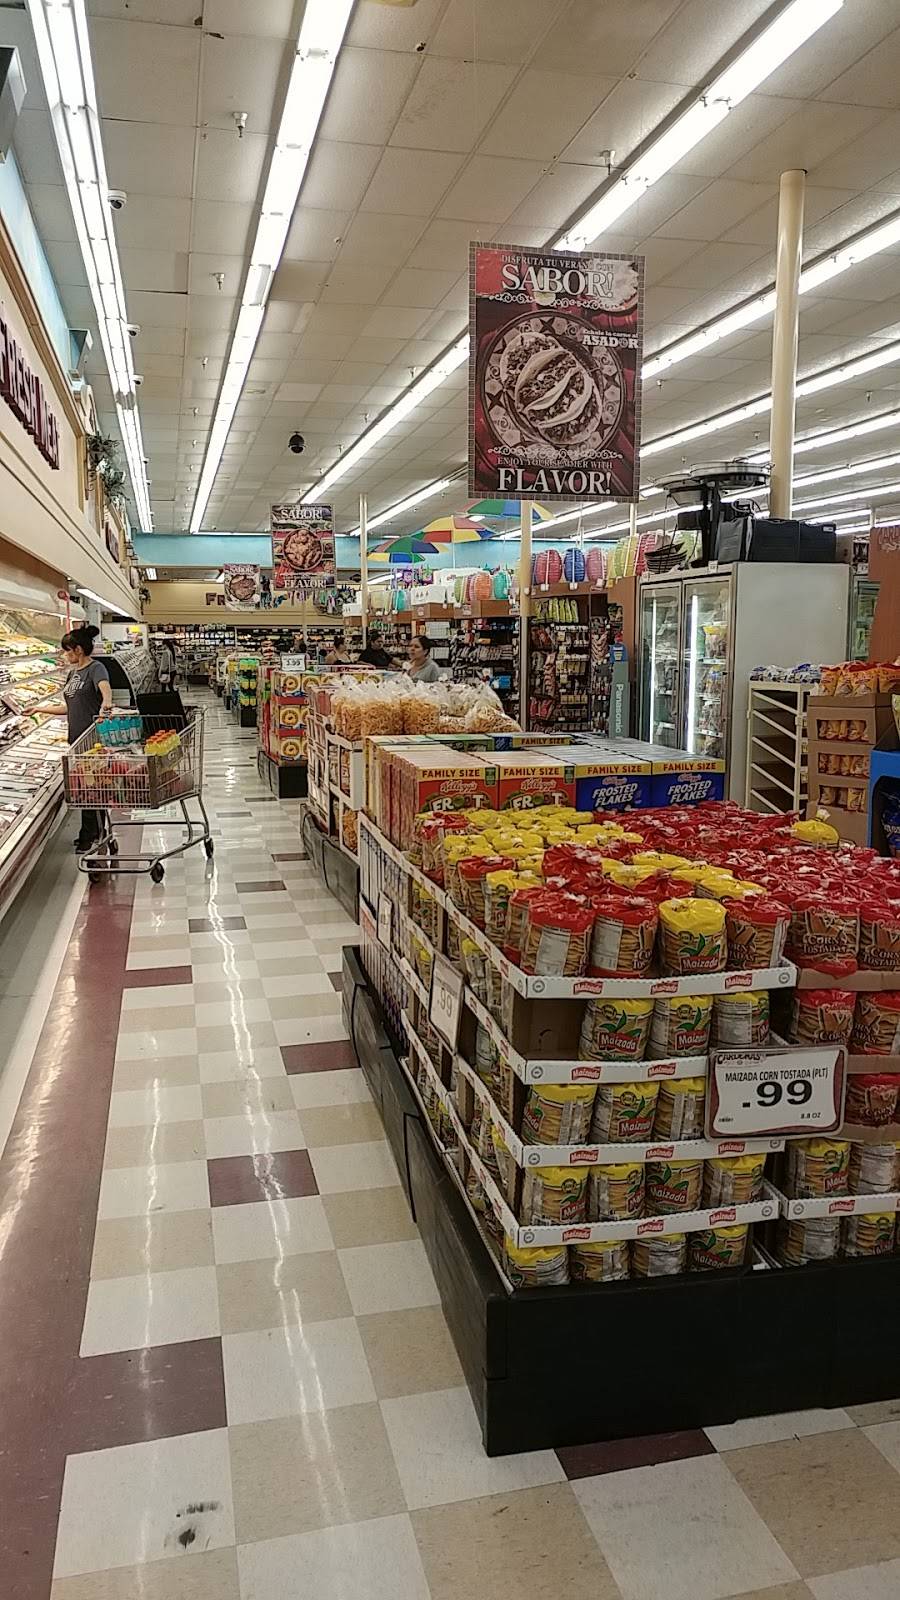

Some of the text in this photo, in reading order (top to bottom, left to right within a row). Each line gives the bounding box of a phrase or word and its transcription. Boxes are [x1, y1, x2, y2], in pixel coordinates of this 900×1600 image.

[501, 254, 545, 266] DISFRUTA
[546, 258, 558, 267] TU
[502, 264, 613, 299] SABOR!
[582, 335, 639, 349] ASADOR
[497, 457, 524, 466] ENJOY
[590, 461, 613, 469] WITH
[497, 467, 612, 494] FLAVOR!
[281, 509, 323, 519] SABOR!
[284, 579, 327, 589] FLAVOR!
[615, 683, 624, 734] Panasonic
[422, 769, 456, 778] FAMILY
[459, 769, 480, 777] SIZE
[504, 768, 537, 776] FAMILY
[539, 767, 560, 775] SIZE
[587, 765, 642, 775] FAMILY SIZE
[663, 762, 716, 771] FAMILY SIZE
[592, 782, 638, 799] FROSTED
[668, 780, 712, 796] FROSTED
[595, 793, 634, 807] FLAKES
[670, 790, 707, 804] FLAKES
[682, 956, 719, 970] Maizada
[600, 1033, 636, 1051] Maizada
[725, 1067, 829, 1082] MAIZADA CORN TOSTADA (PLT)
[742, 1079, 813, 1108] .99
[651, 1185, 687, 1203] Maizada
